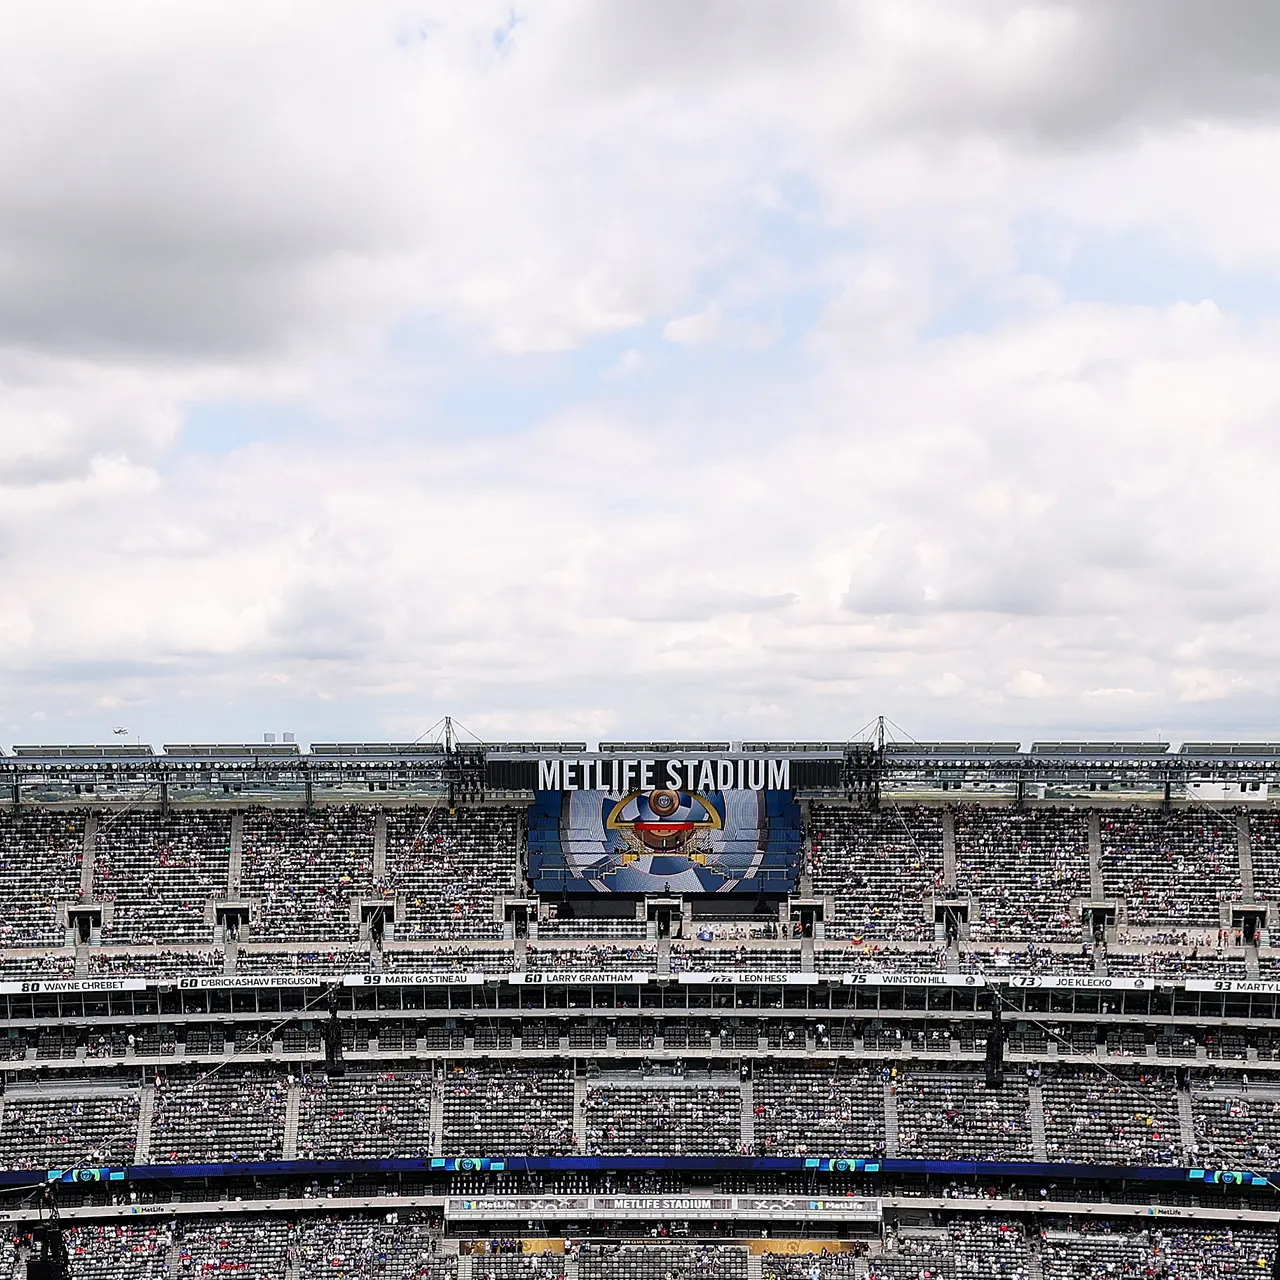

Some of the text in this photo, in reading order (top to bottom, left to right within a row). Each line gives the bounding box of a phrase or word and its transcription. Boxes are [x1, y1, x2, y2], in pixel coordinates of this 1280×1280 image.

[538, 759, 790, 791] METLIFE STADIUM
[180, 976, 319, 988] 60 D'BRICKASHAW FERGUSON
[363, 974, 468, 985] 99 MARK GASTINEAU
[546, 973, 577, 984] LARRY
[579, 973, 633, 984] GRANTHAM
[739, 973, 763, 983] LEON
[764, 973, 788, 983] HESS
[851, 973, 947, 985] 75 WINSTON HILL
[1055, 977, 1073, 987] JOE
[1074, 977, 1112, 988] KLECKO
[21, 980, 125, 993] 80 WAYNE CHREBET
[1214, 980, 1231, 991] 93
[1236, 981, 1273, 992] MARTY
[478, 1201, 516, 1209] MetLife
[614, 1199, 711, 1209] METLIFE STADIUM
[825, 1201, 863, 1209] MetLife
[141, 1206, 165, 1214] MetLife
[1157, 1208, 1181, 1216] MetLife
